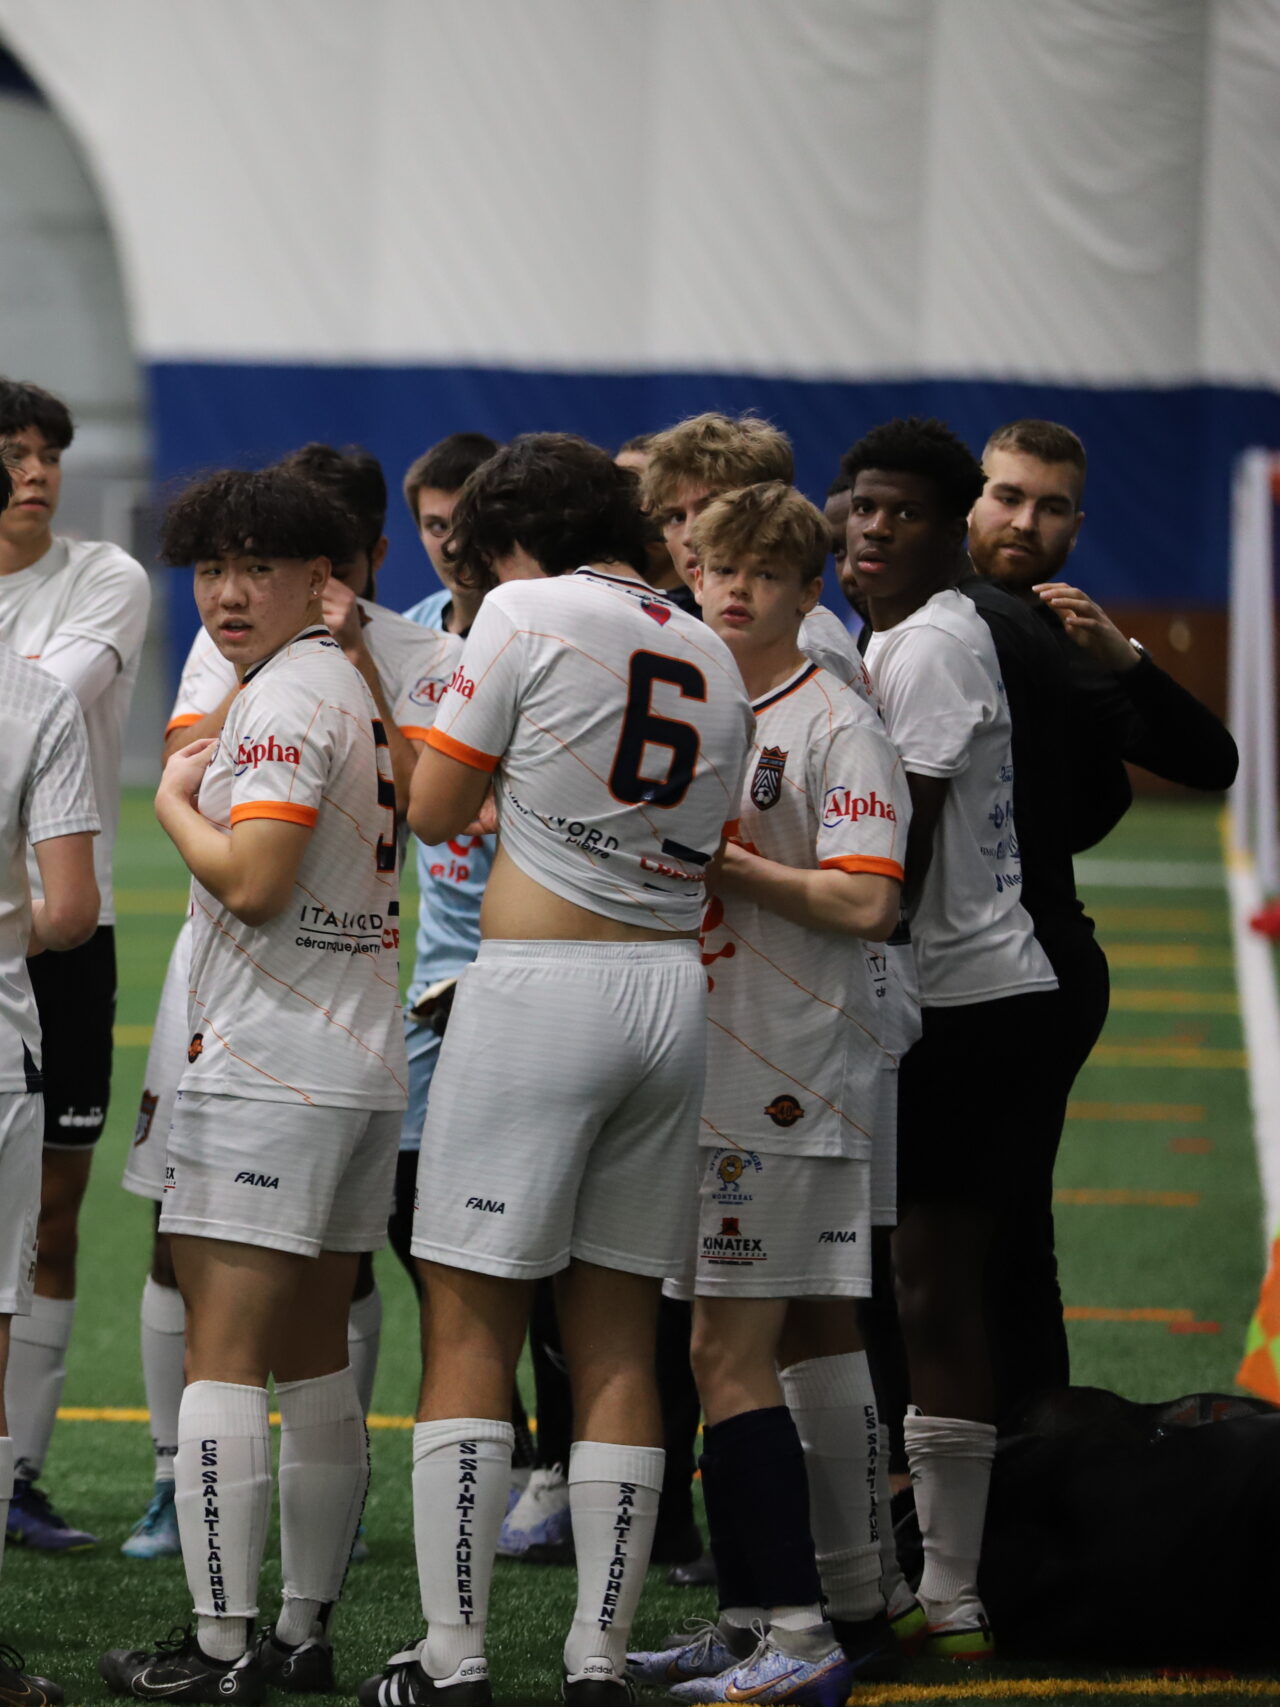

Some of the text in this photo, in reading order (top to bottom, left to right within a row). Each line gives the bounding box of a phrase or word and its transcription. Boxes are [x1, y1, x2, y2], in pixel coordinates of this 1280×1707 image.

[609, 649, 707, 809] 6
[825, 790, 897, 822] Alpha
[235, 1171, 280, 1190] FANA
[465, 1197, 505, 1214] FANA
[703, 1237, 762, 1251] KINATEX
[818, 1231, 857, 1244] FANA
